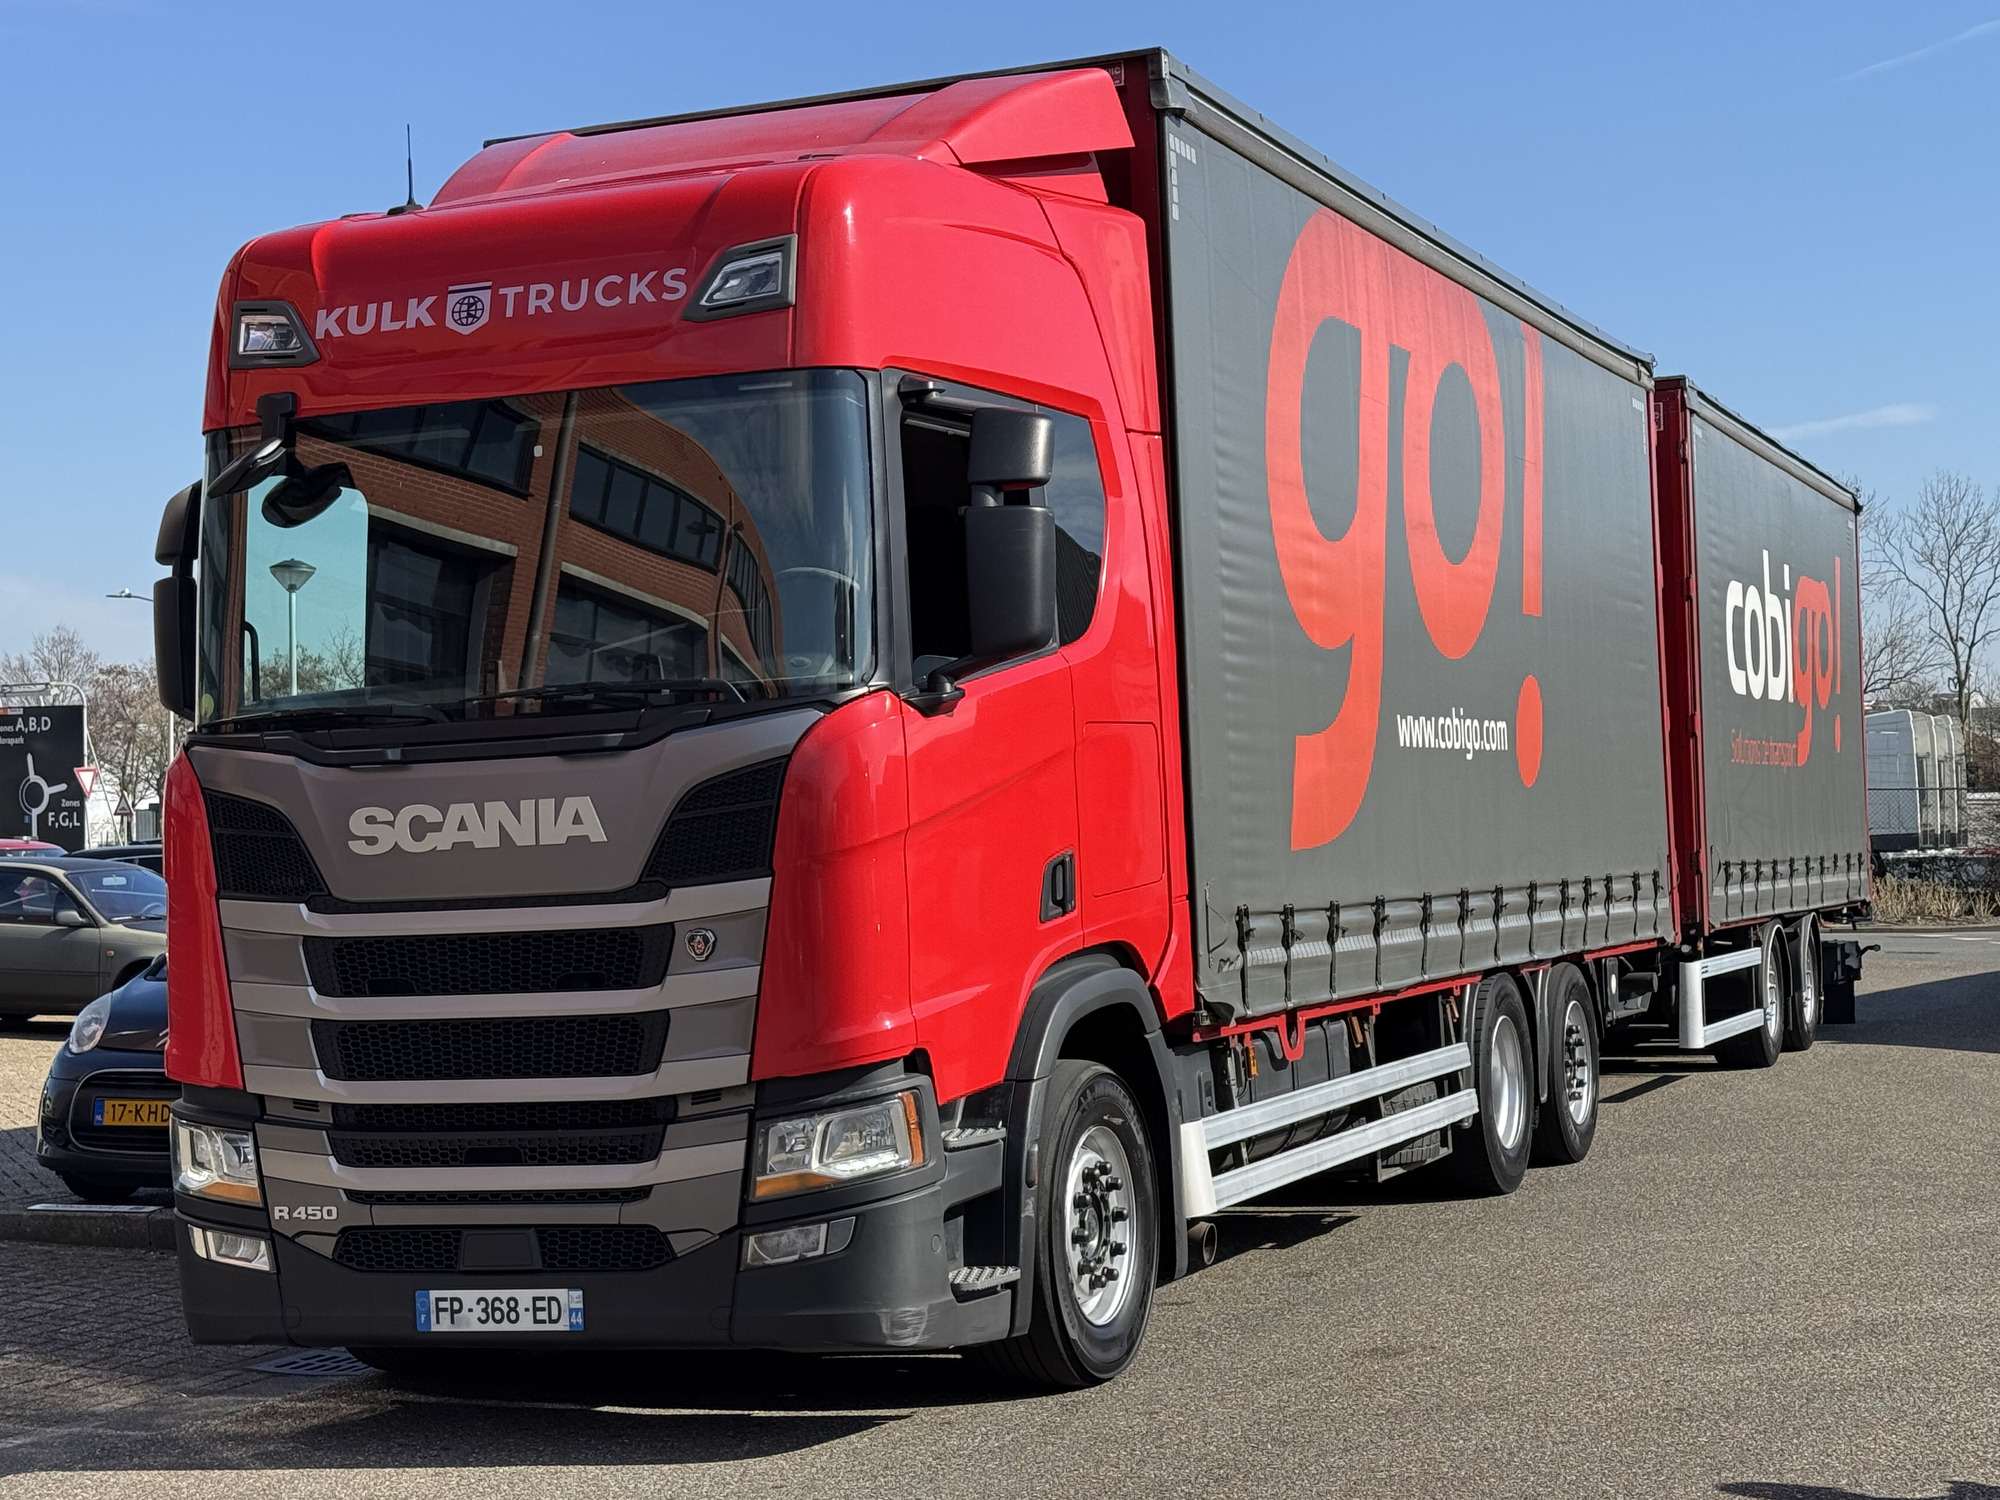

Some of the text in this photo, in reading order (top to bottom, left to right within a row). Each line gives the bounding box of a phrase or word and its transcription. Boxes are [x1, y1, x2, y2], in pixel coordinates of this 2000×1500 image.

[315, 268, 688, 340] KULK TRUCKS
[1266, 207, 1543, 851] go!
[1726, 549, 1841, 767] cobigo!
[15, 716, 52, 733] A,B,D
[0, 735, 25, 747] lorapark
[1397, 707, 1508, 761] www.cobigo.com
[61, 798, 80, 807] Zones
[48, 811, 81, 829] F,G,L
[348, 796, 608, 856] SCANIA
[274, 1206, 338, 1220] R 450
[420, 1314, 426, 1324] F
[434, 1295, 562, 1325] FP-368-ED
[570, 1311, 583, 1326] 44
